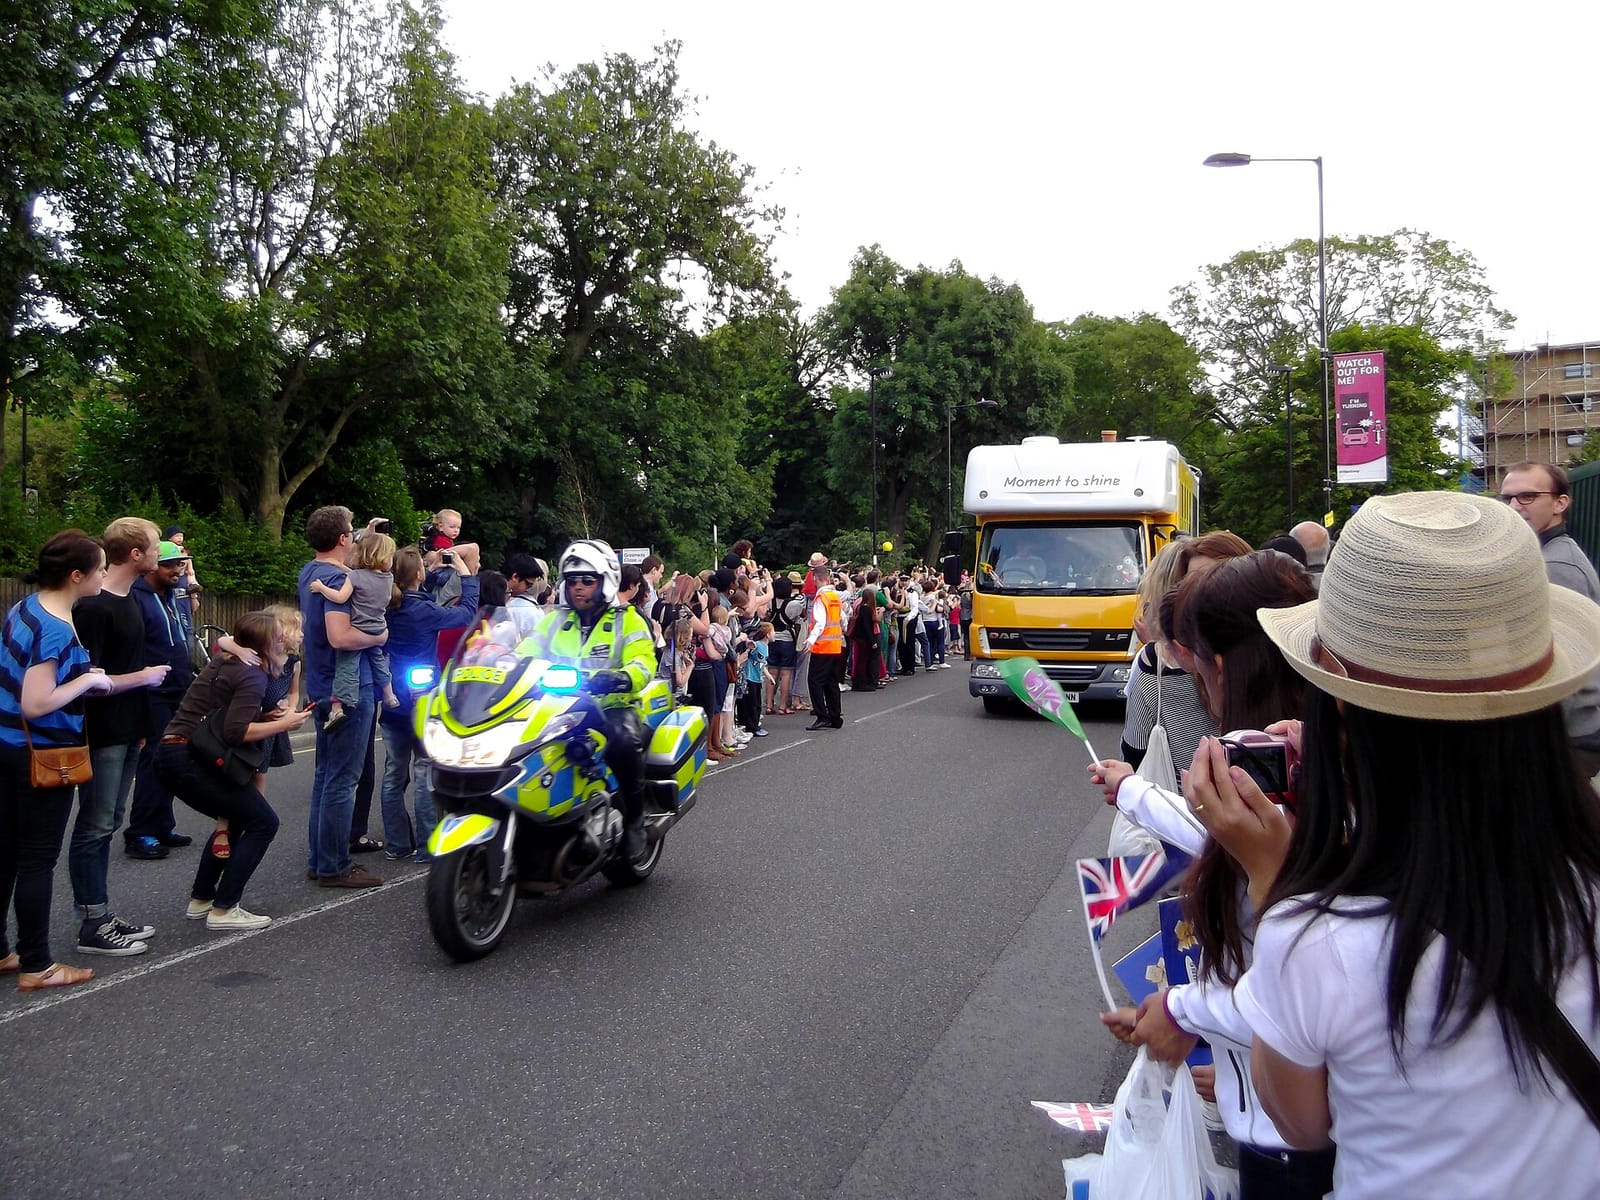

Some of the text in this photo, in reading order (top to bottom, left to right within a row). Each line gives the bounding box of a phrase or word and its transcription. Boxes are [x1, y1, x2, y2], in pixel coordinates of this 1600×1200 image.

[1336, 359, 1371, 368] WATCH
[1337, 366, 1379, 377] OUT FOR
[1004, 474, 1121, 488] Moment to shine
[989, 632, 1020, 640] DAF
[1105, 633, 1129, 641] LF
[456, 668, 502, 681] POLICE
